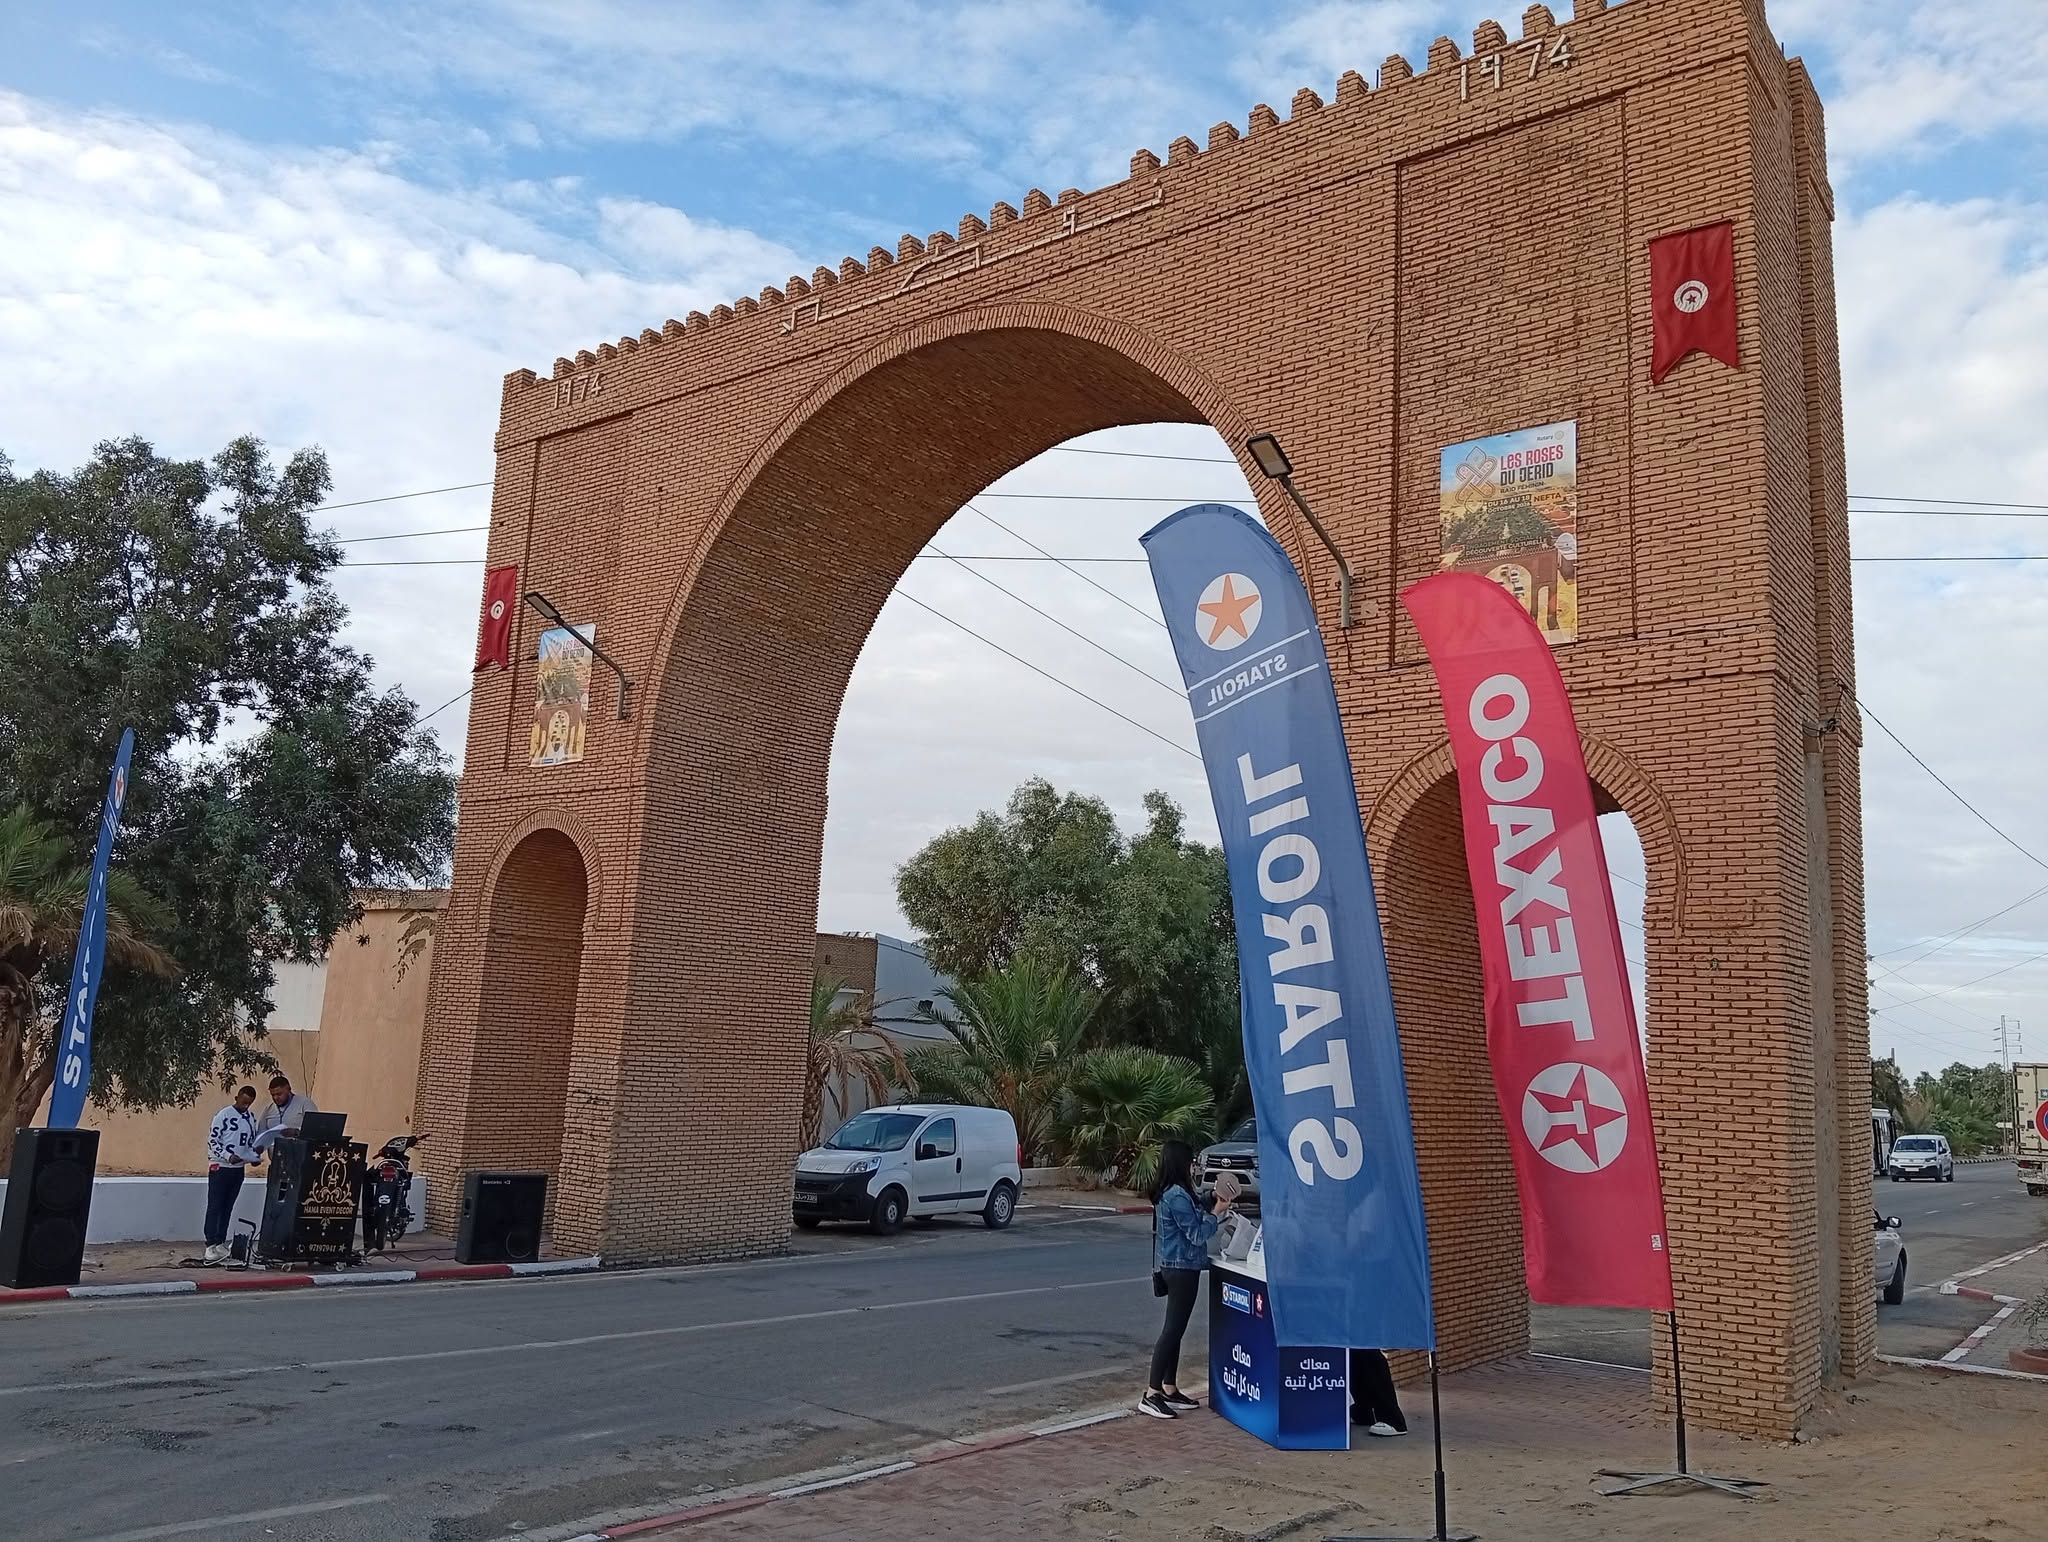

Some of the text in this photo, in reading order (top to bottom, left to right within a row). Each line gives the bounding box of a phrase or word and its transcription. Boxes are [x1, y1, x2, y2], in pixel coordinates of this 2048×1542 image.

[1460, 34, 1573, 101] 1974
[554, 373, 602, 409] 1974
[1526, 444, 1564, 466] ROSES
[1500, 469, 1516, 487] DU
[1487, 500, 1499, 508] DU
[1510, 496, 1521, 504] AU
[1533, 492, 1562, 503] NEFTA
[320, 1205, 336, 1215] EVENT
[336, 1206, 354, 1216] DECOR
[1229, 1289, 1250, 1308] STAROIL
[1232, 1343, 1251, 1368] معاك
[1300, 1358, 1330, 1371] معاك
[1223, 1366, 1261, 1402] في كل ثنية
[1284, 1374, 1346, 1391] في كل ثنية
